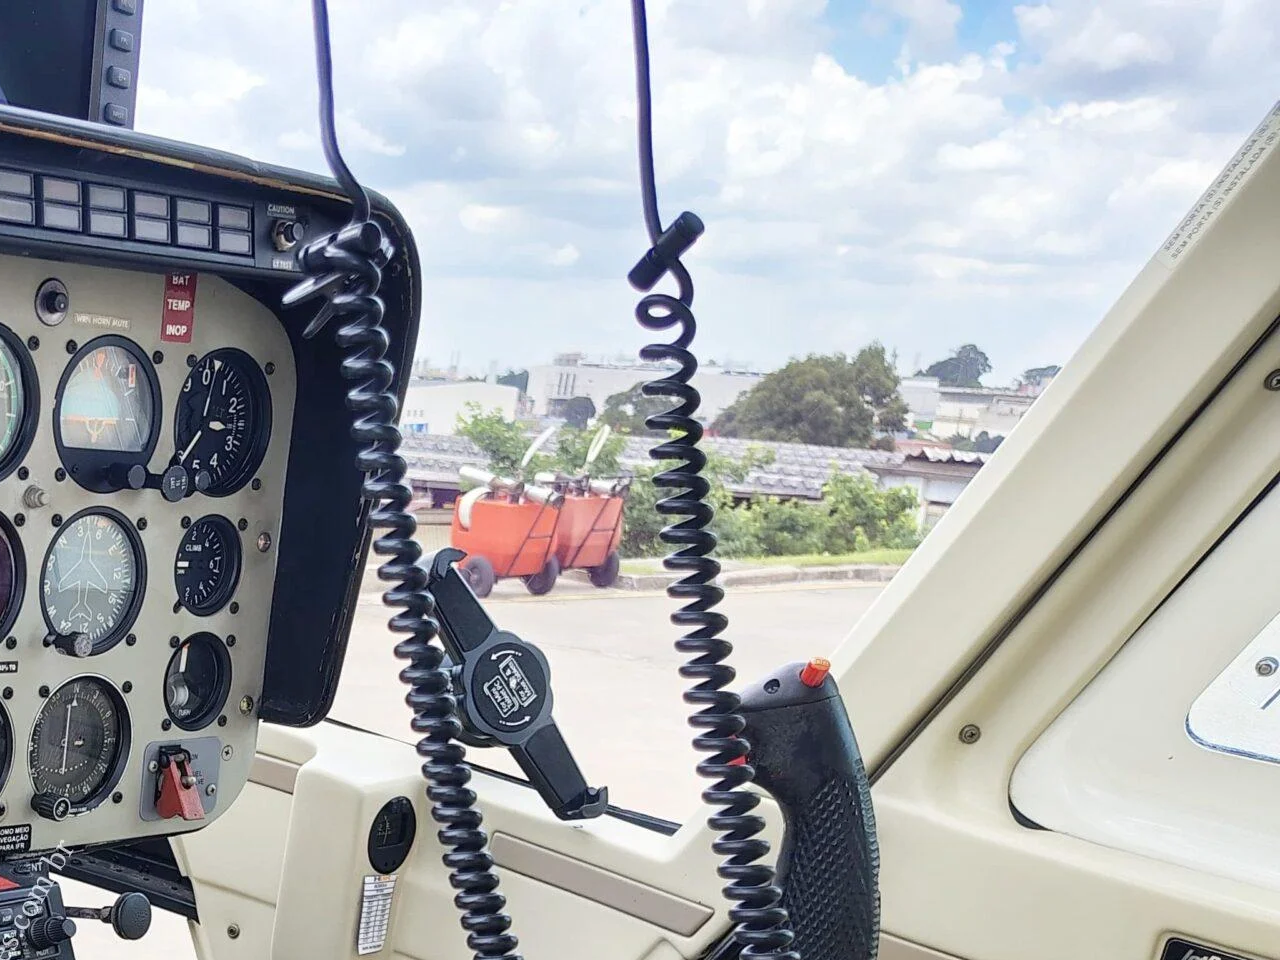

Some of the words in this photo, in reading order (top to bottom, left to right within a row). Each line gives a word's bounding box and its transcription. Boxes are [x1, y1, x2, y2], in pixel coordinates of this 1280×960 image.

[268, 204, 295, 214] CAUTION
[172, 275, 190, 285] BAT
[167, 299, 191, 311] TEMP
[93, 317, 111, 327] HORN
[112, 319, 128, 328] MUTE
[166, 324, 187, 336] INOP
[185, 544, 202, 552] CLIMB
[15, 826, 30, 834] MEIO
[0, 844, 14, 852] PARA
[15, 842, 25, 850] IFR
